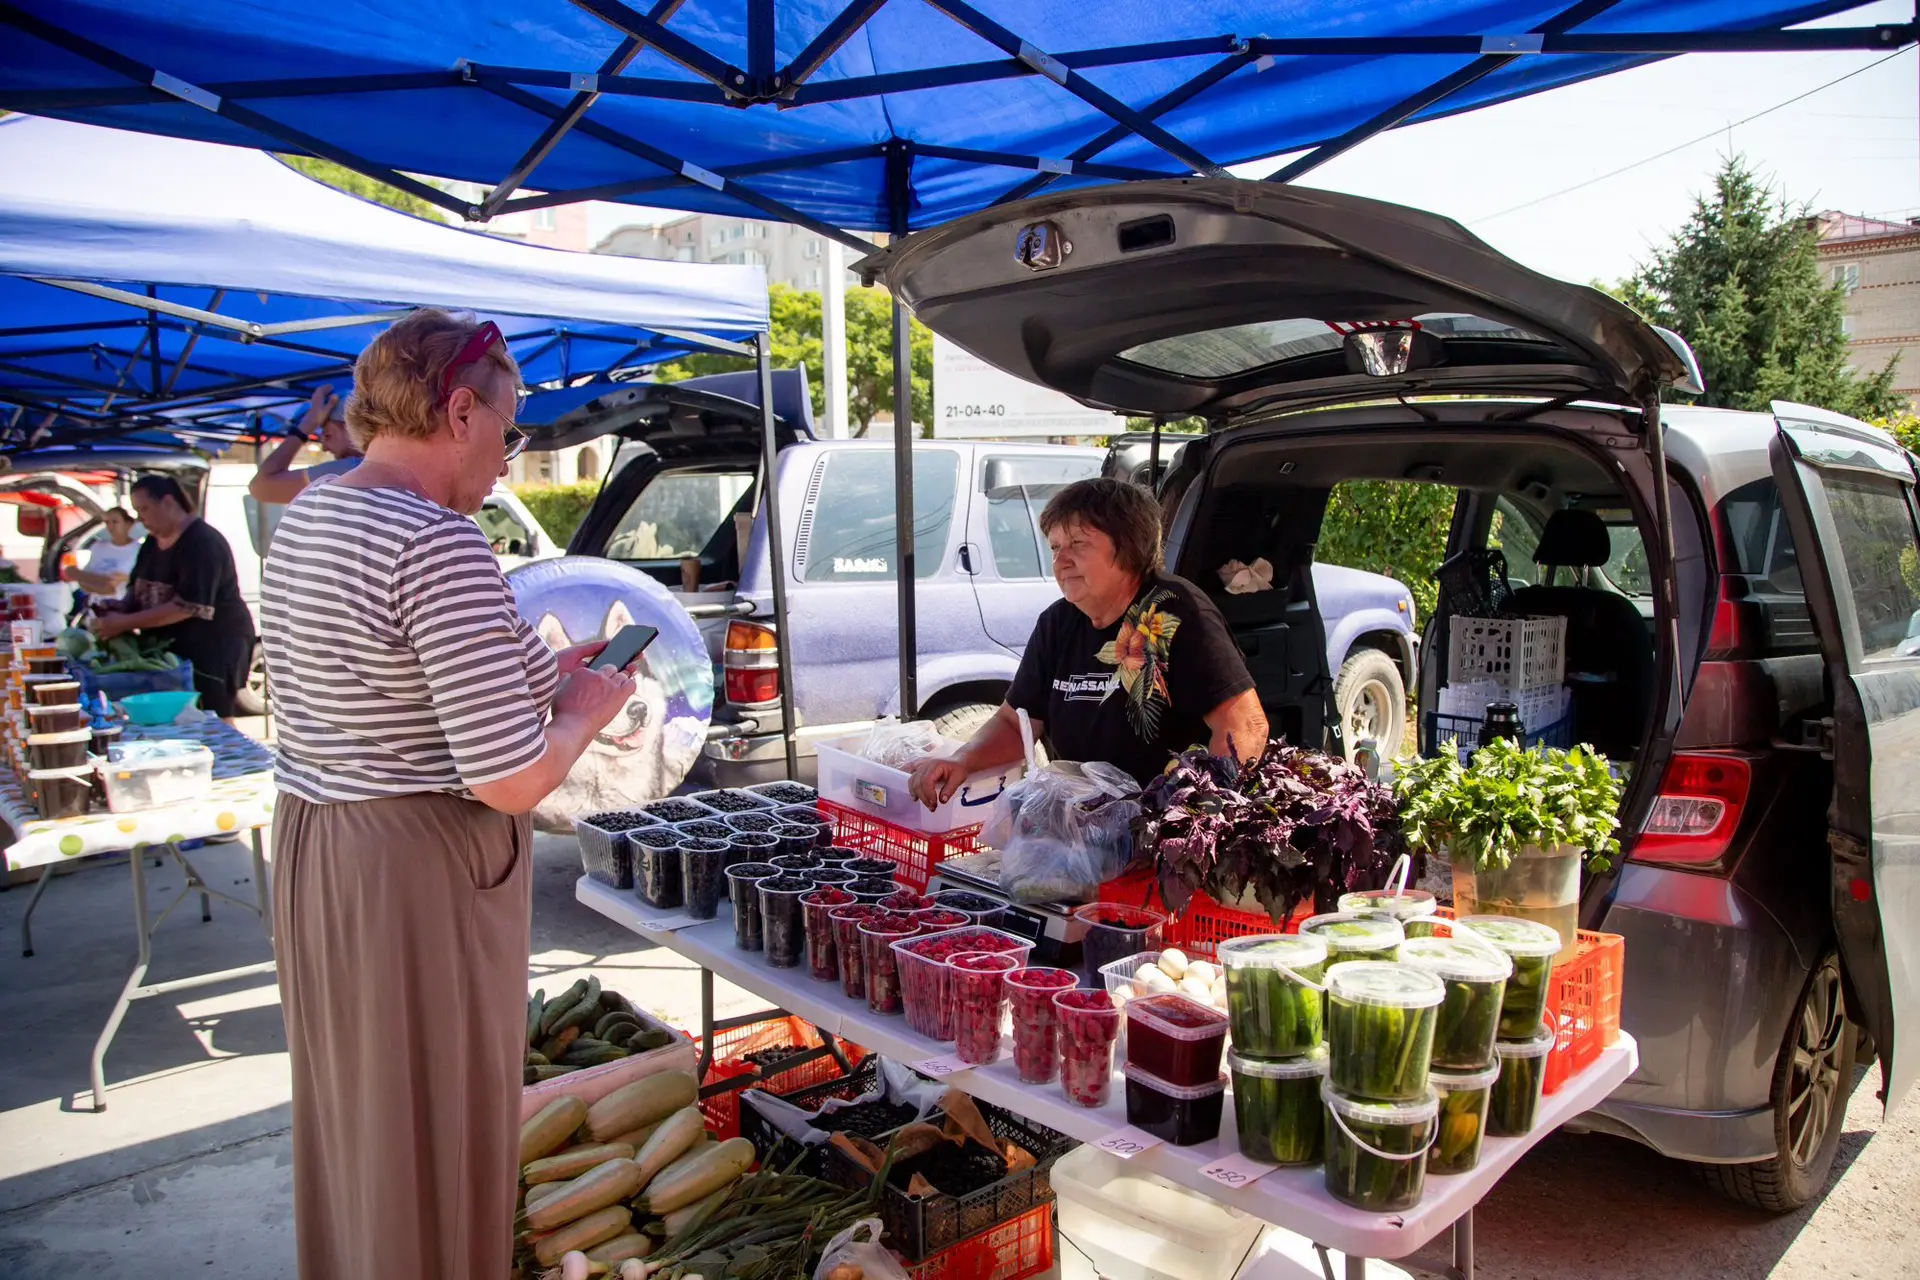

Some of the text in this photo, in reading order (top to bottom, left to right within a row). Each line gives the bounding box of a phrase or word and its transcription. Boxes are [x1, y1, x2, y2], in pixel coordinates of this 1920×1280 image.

[945, 404, 1005, 418] 21-04-40
[1101, 1138, 1144, 1153] 500
[1206, 1168, 1246, 1182] 250
